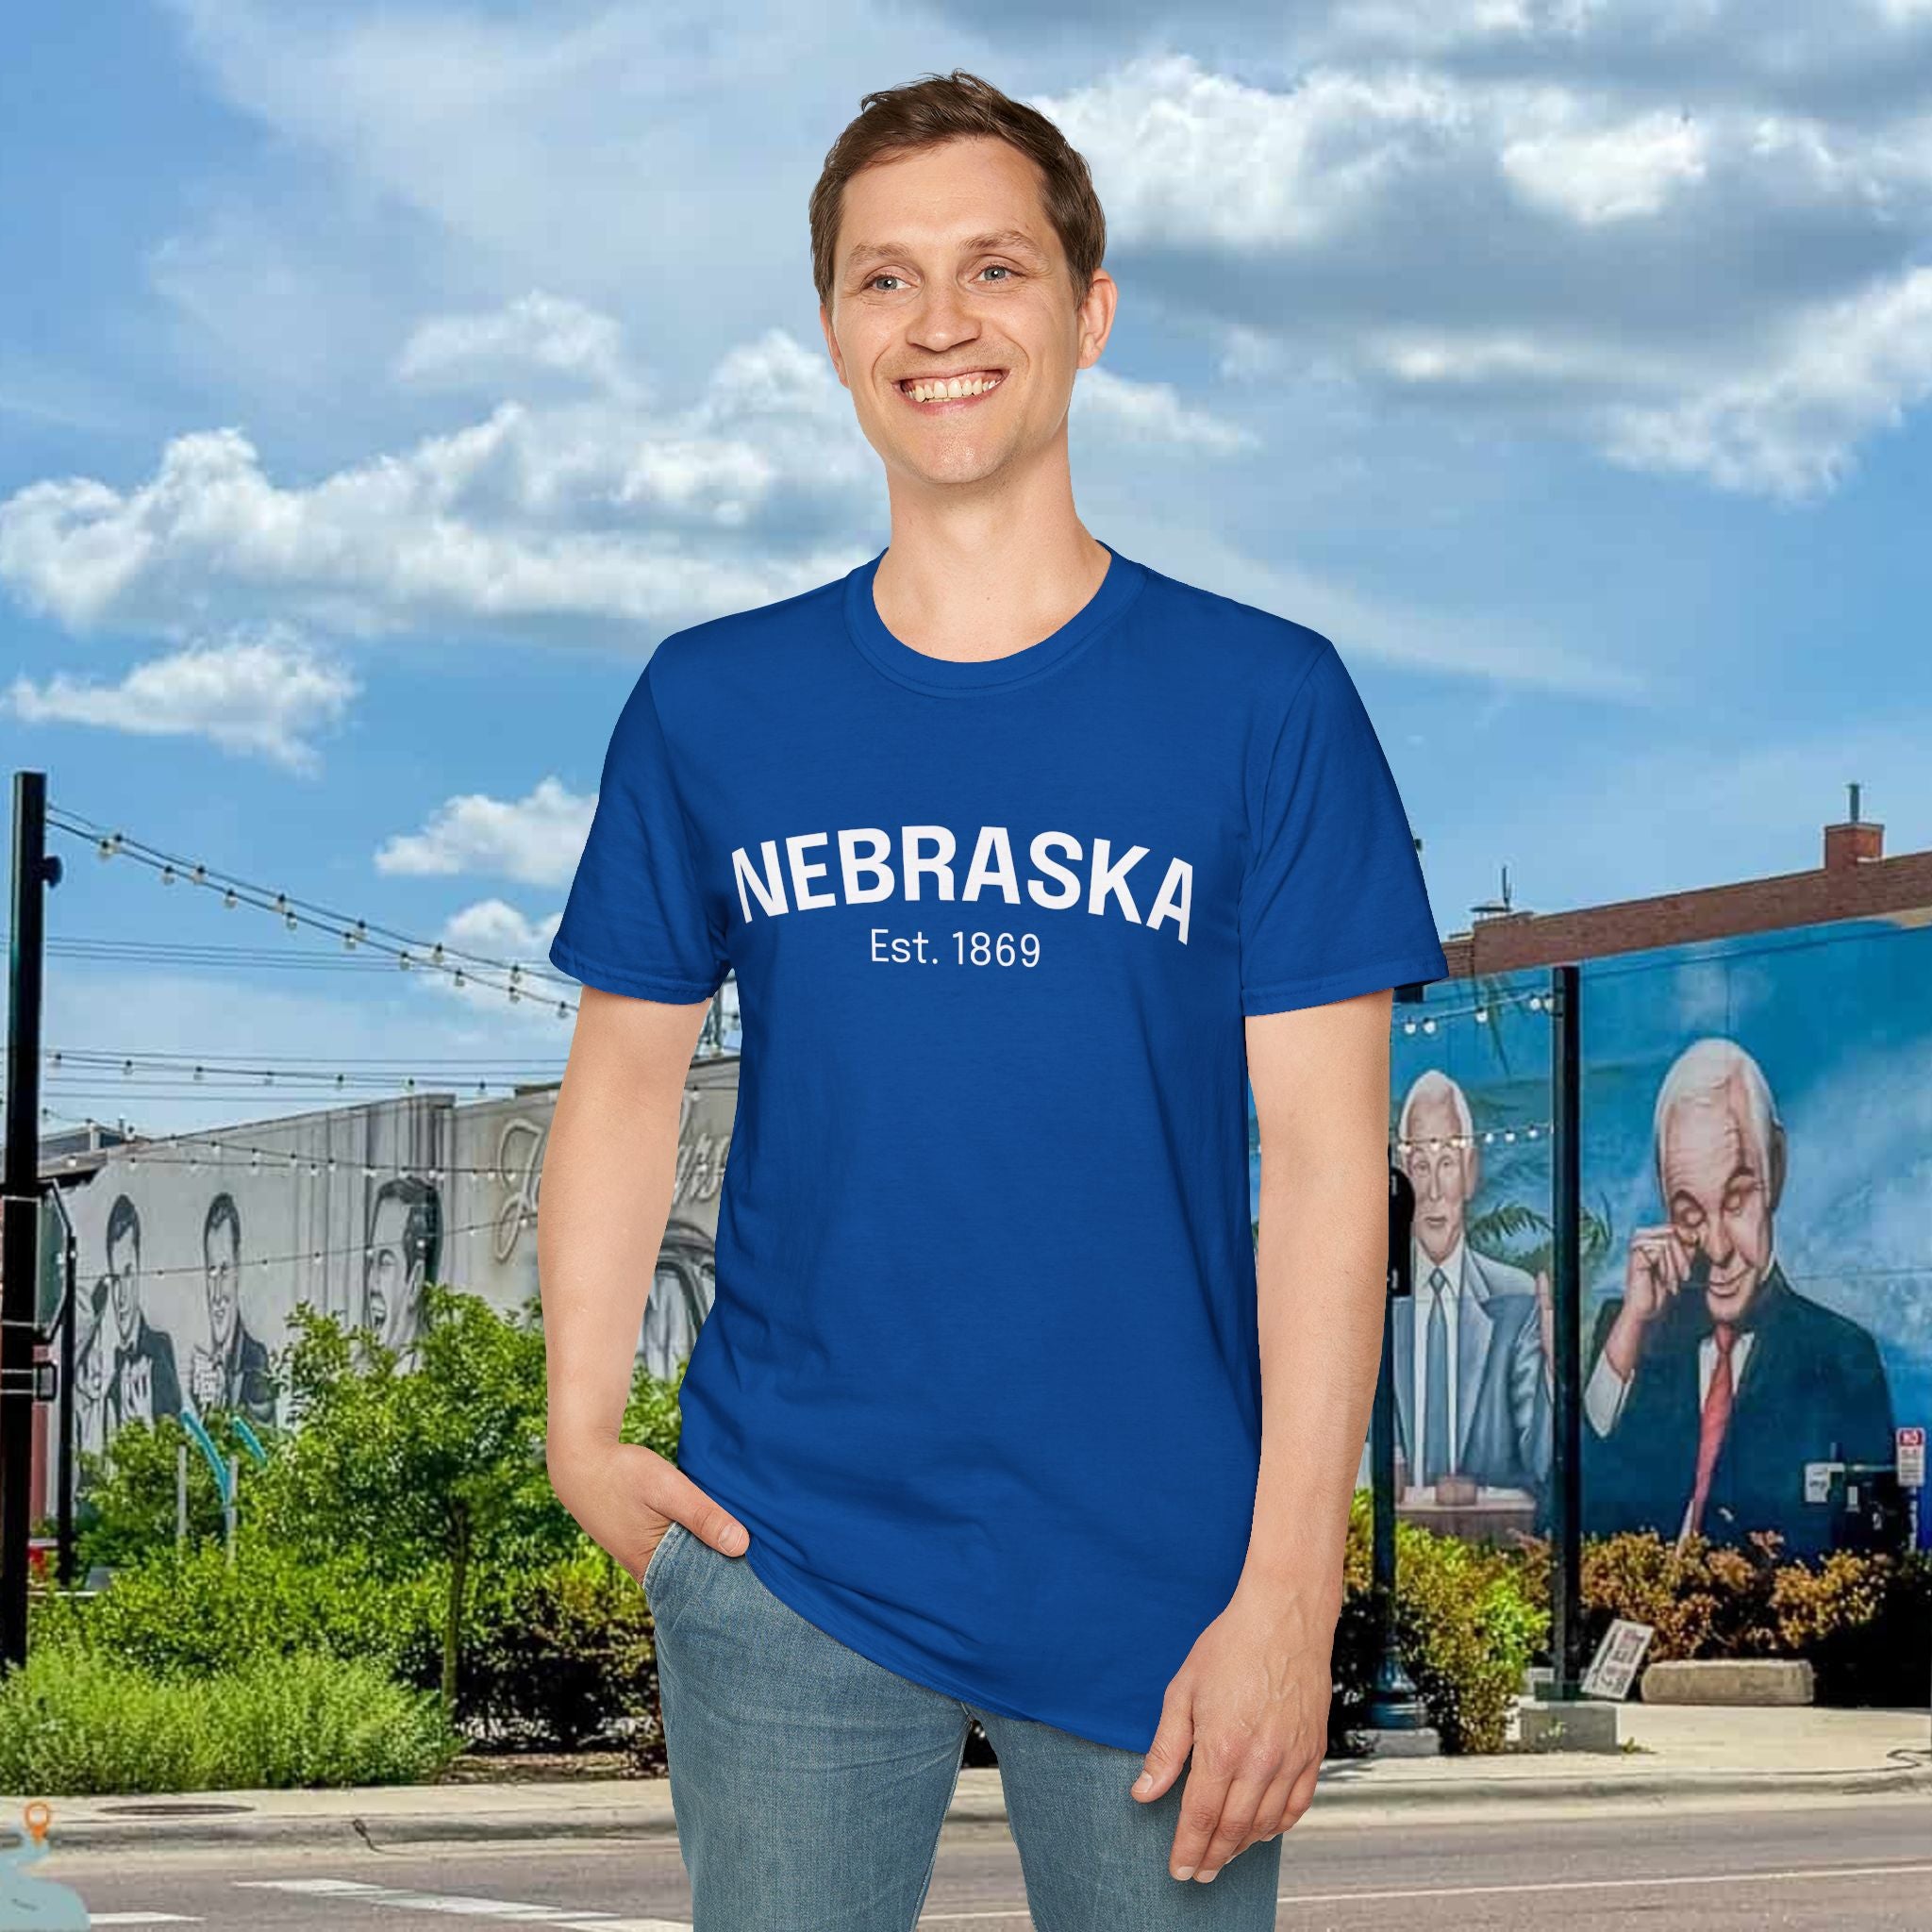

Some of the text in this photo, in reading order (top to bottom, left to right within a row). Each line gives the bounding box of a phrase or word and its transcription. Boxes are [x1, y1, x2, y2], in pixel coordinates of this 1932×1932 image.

[732, 824, 1193, 945] NEBRASKA
[871, 928, 1041, 968] Est. 1869
